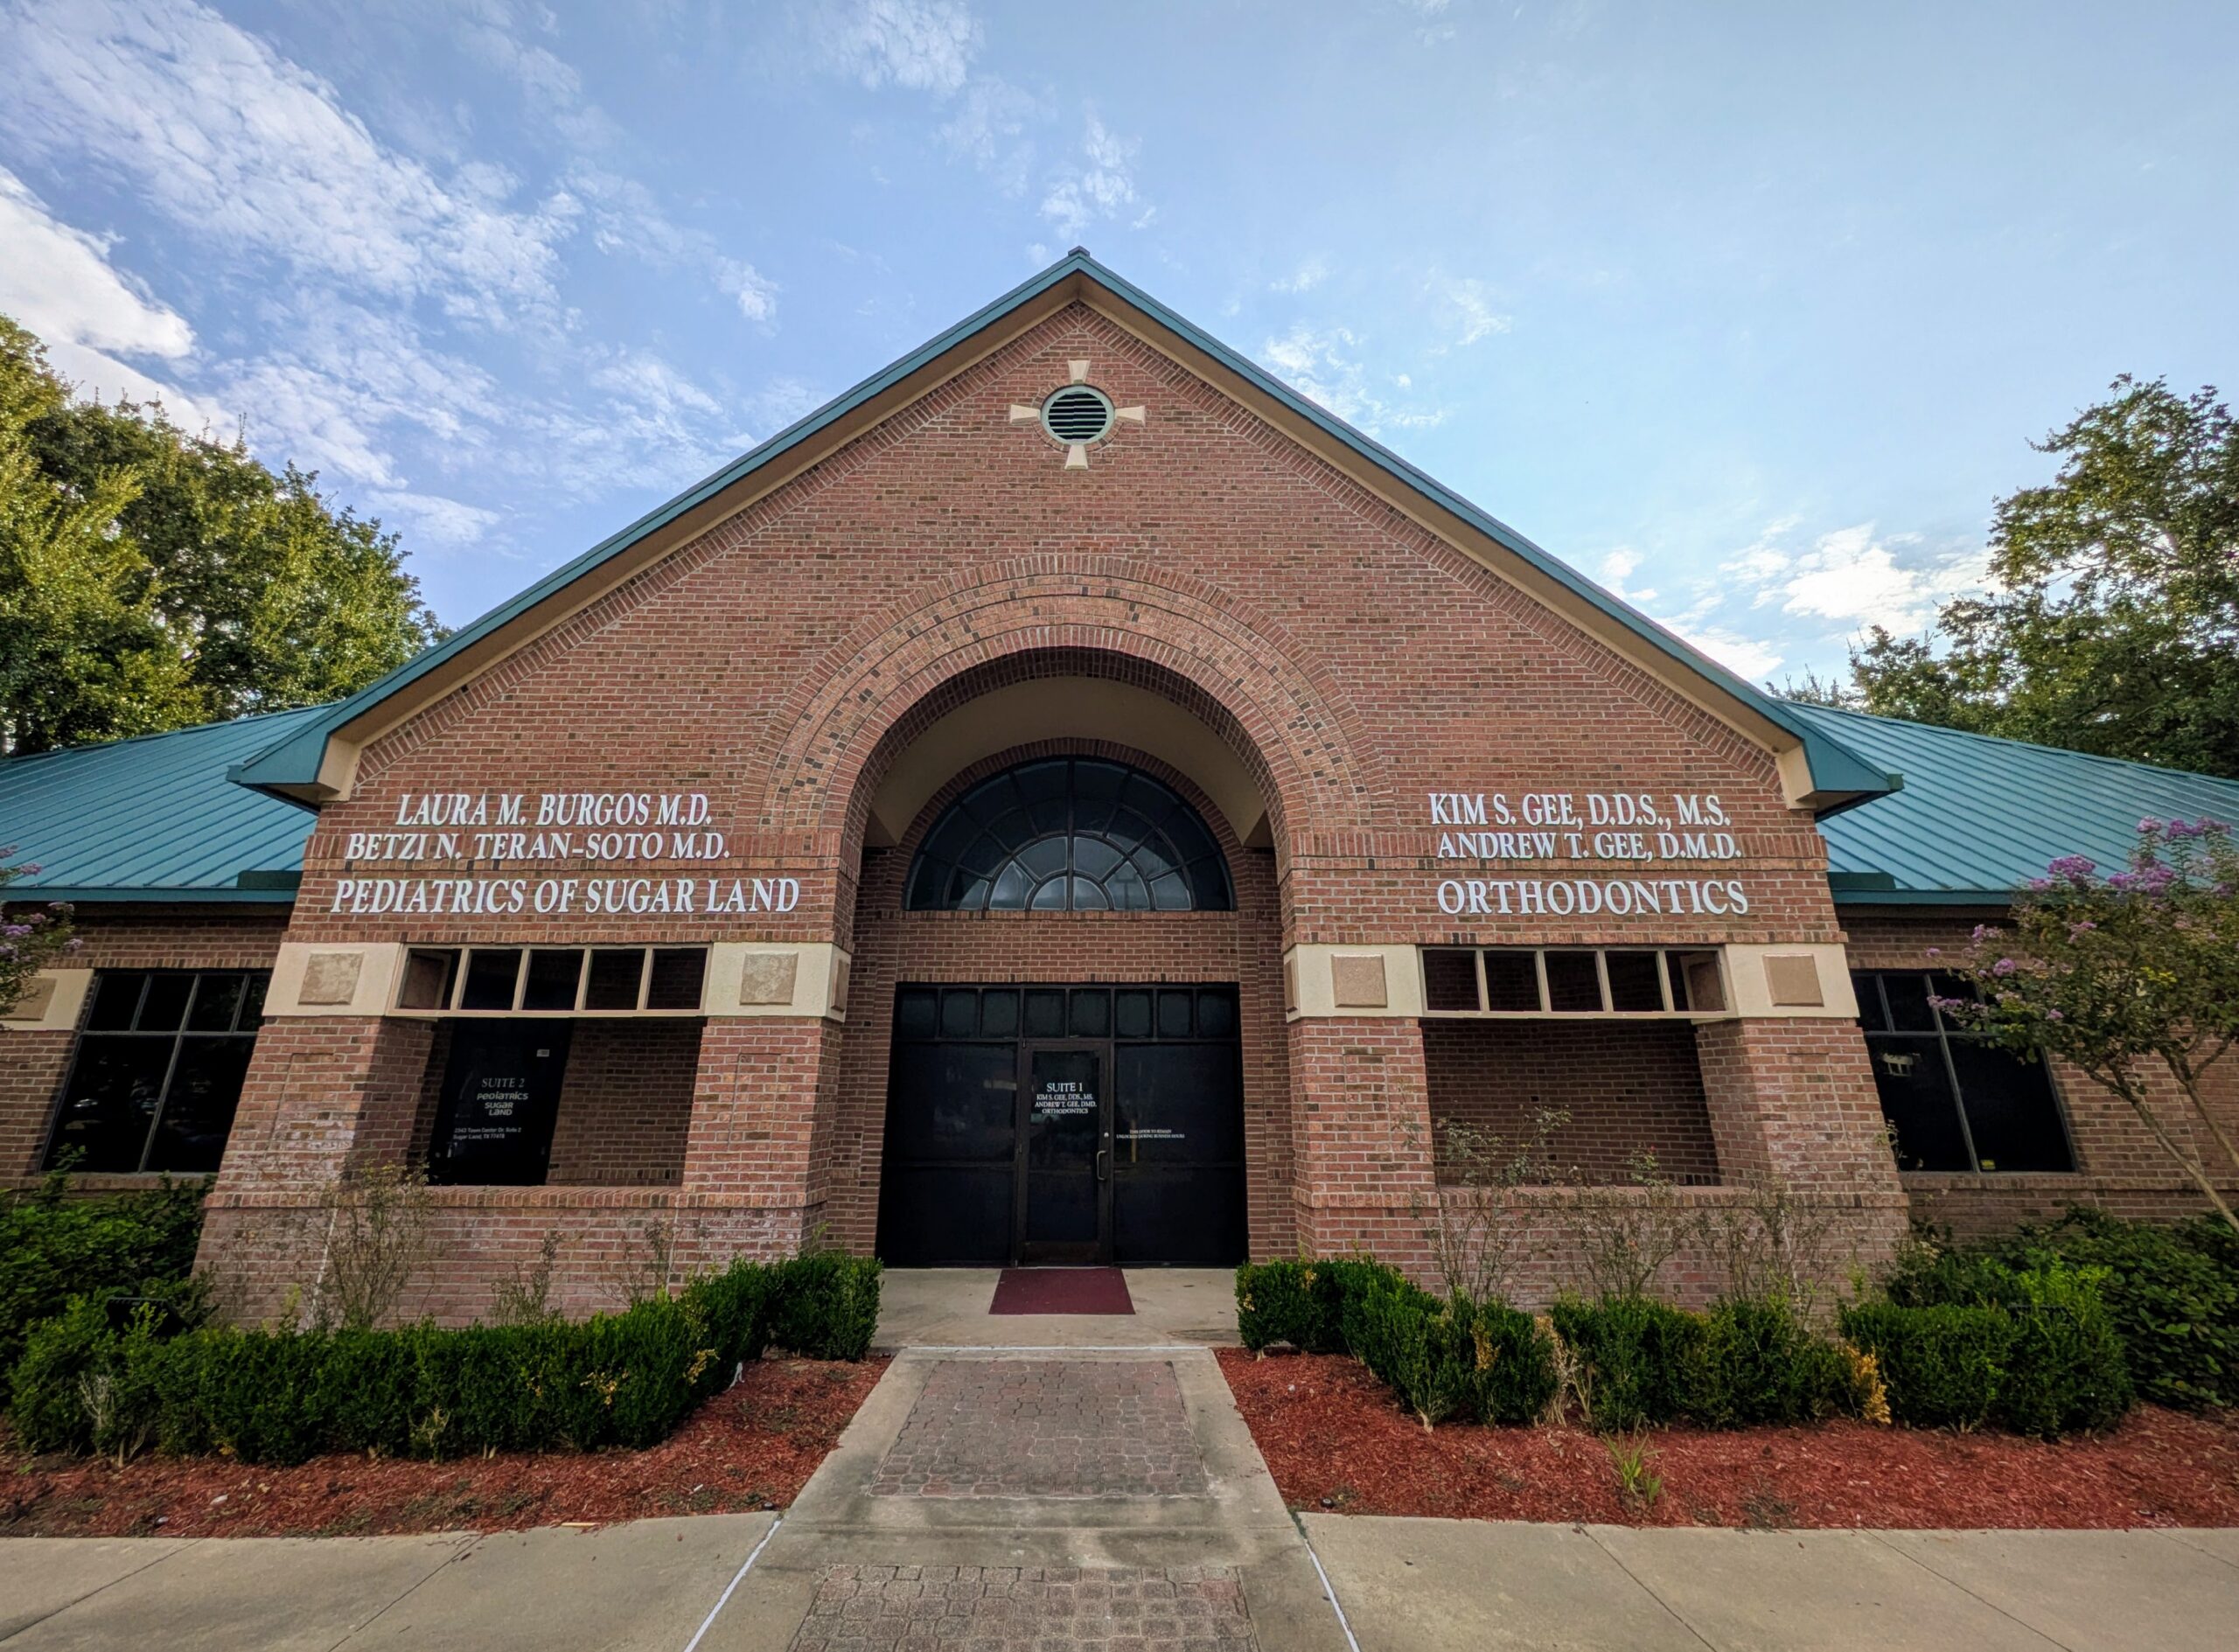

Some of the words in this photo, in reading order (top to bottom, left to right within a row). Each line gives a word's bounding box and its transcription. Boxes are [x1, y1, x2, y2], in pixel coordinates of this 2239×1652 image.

[395, 793, 487, 826] LAURA
[495, 794, 527, 826] M.
[535, 793, 651, 826] BURGOS
[654, 793, 713, 826] M.D.
[1427, 793, 1489, 826] KIM
[1495, 793, 1517, 826] S.
[1522, 793, 1585, 831] GEE,
[1587, 793, 1672, 832] D.D.S.,
[1673, 794, 1732, 826] M.S.
[345, 833, 426, 861] BETZI
[436, 833, 463, 860] N.
[475, 832, 664, 861] TERAN-SOTO
[670, 832, 730, 861] M.D.
[1437, 832, 1557, 860] ANDREW
[1564, 833, 1589, 860] T.
[1594, 833, 1653, 863] GEE,
[1657, 833, 1742, 861] D.M.D.
[330, 879, 527, 914] PEDIATRICS
[534, 879, 580, 914] OF
[585, 879, 695, 914] SUGAR
[706, 877, 799, 913] LAND
[1437, 880, 1749, 916] ORTHODONTICS
[481, 1077, 516, 1089] SUITE
[518, 1077, 526, 1088] 2
[1046, 1083, 1077, 1092] SUITE
[1078, 1083, 1084, 1091] 1
